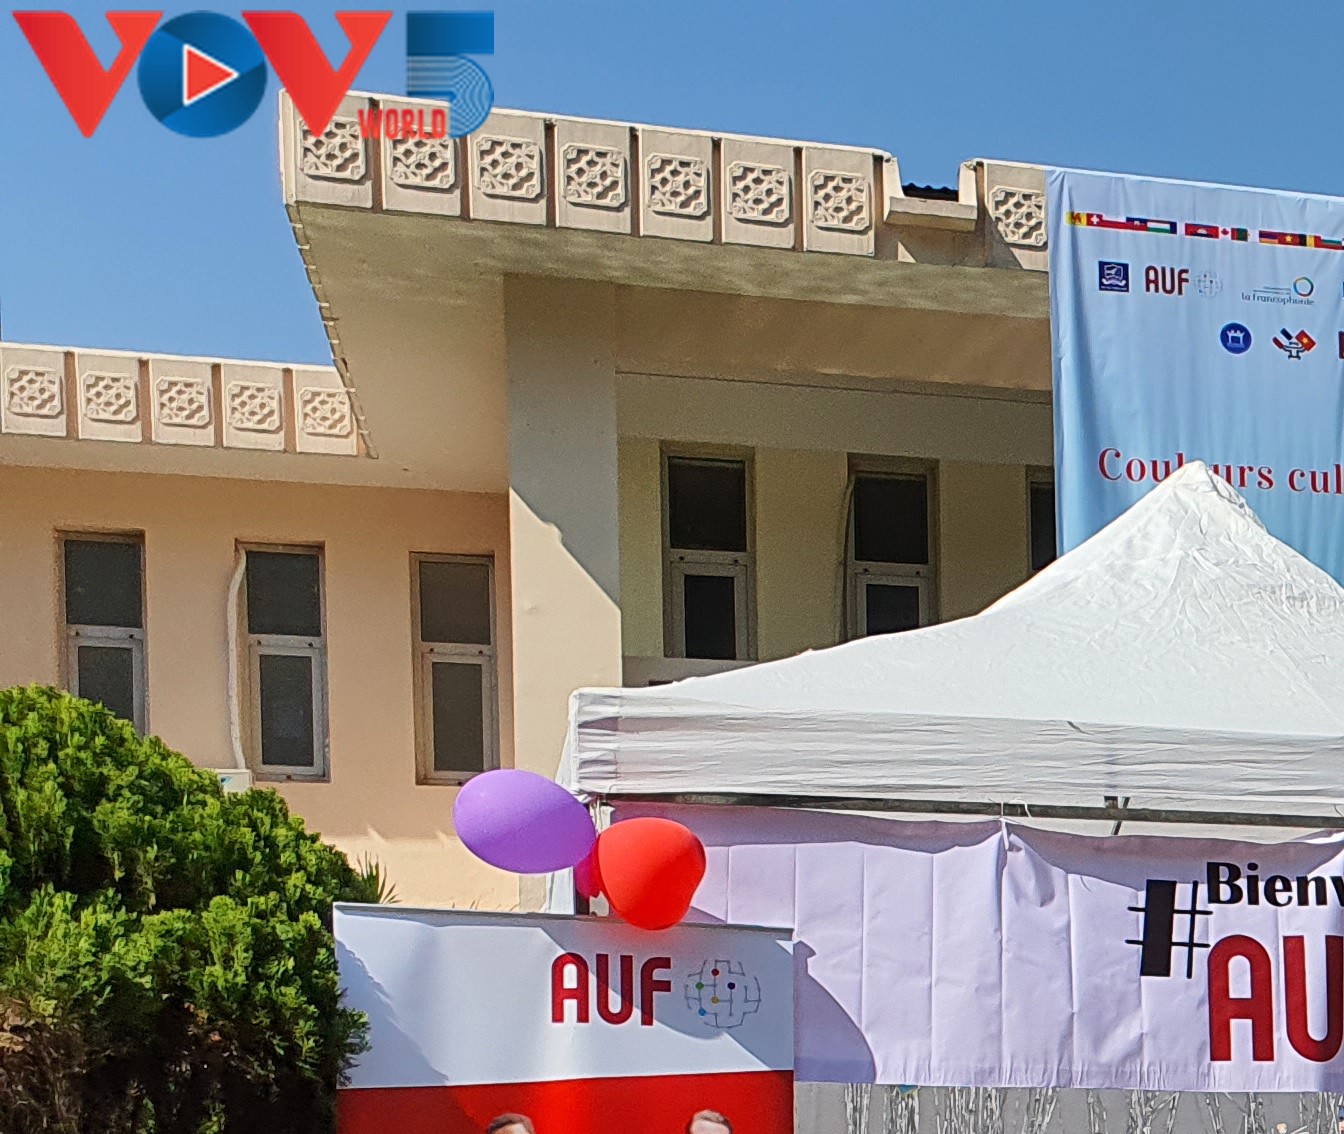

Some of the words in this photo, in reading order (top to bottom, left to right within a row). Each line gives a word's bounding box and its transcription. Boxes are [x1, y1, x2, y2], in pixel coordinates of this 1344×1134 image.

[1145, 265, 1189, 295] AUF
[1098, 447, 1275, 490] Coulurs
[551, 952, 672, 1027] AUF
